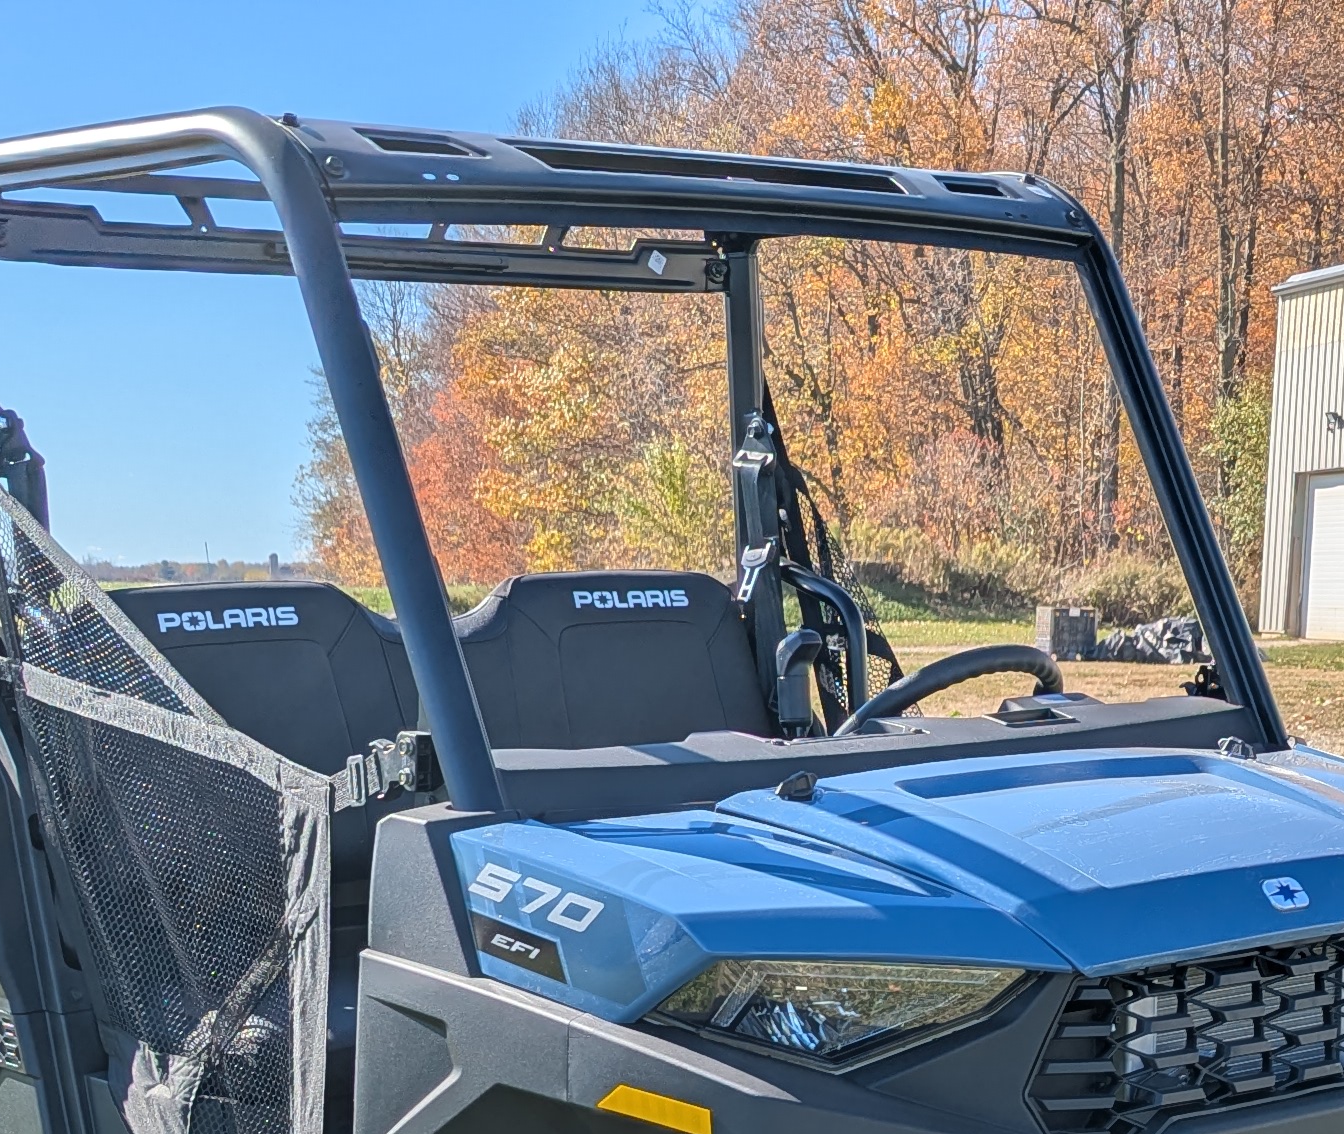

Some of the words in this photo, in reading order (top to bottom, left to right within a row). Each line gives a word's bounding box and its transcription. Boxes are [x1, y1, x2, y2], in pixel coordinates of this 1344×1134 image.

[573, 590, 689, 608] POLARIS
[157, 606, 299, 632] POLARIS
[468, 862, 605, 932] 570
[491, 933, 540, 959] EFI
